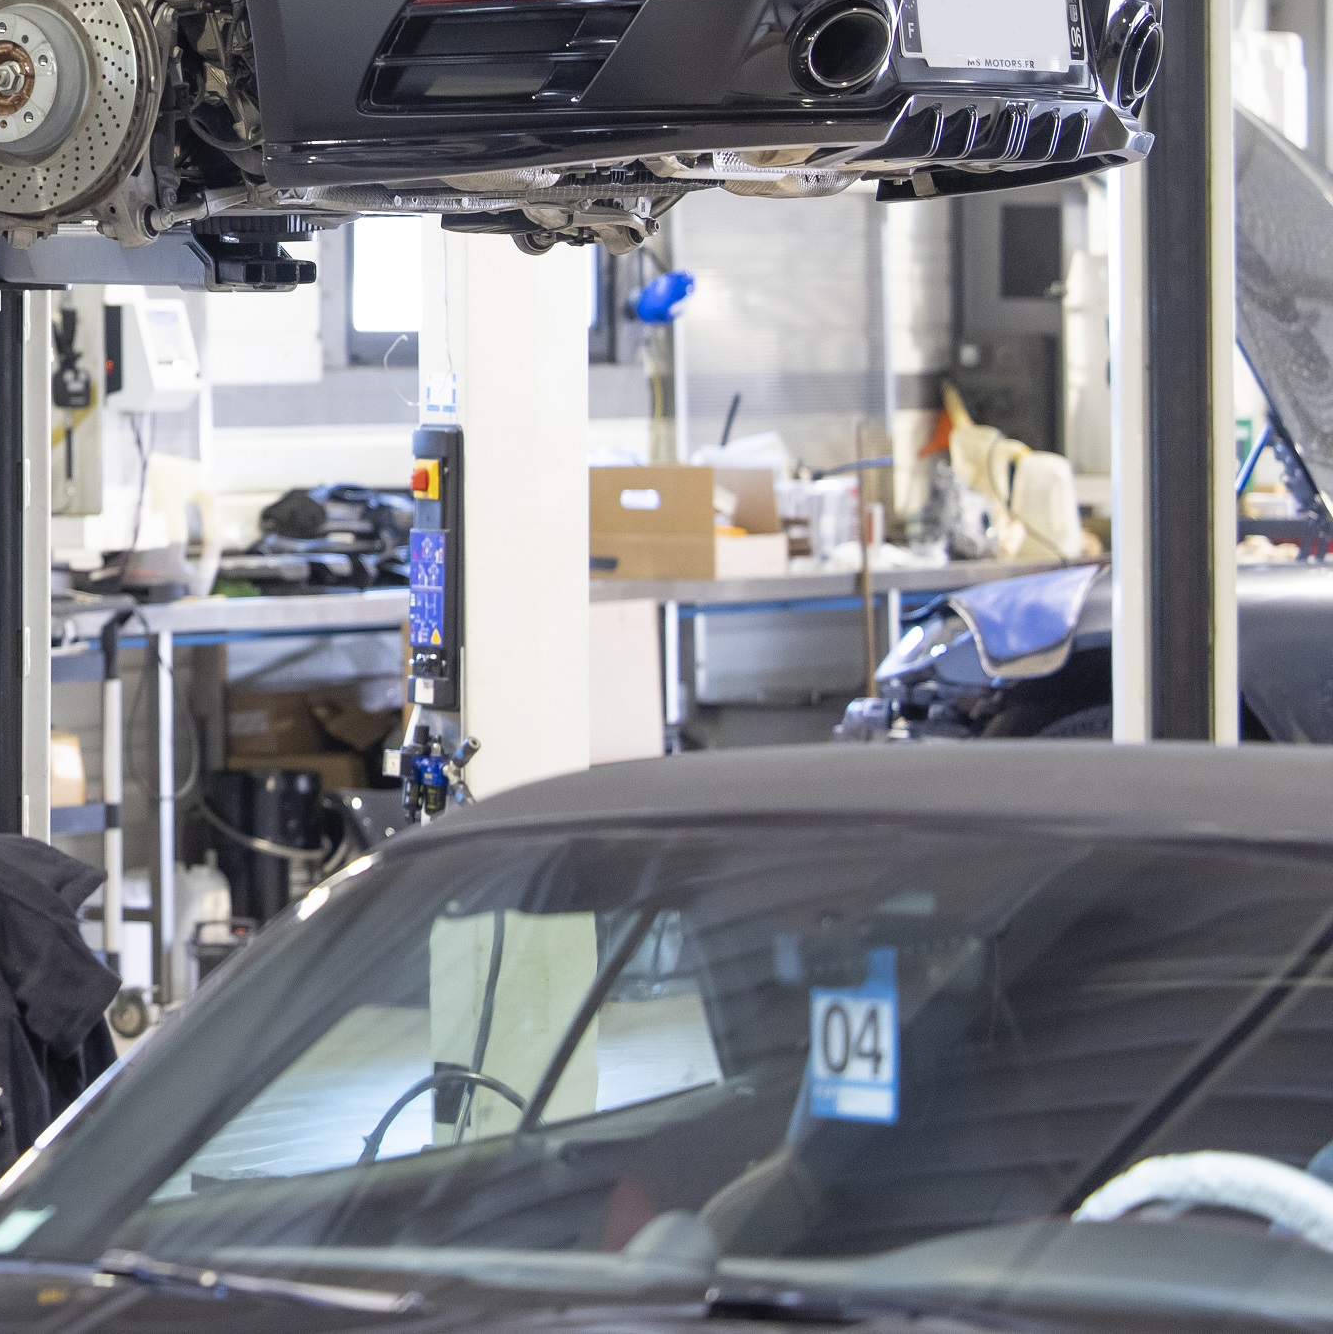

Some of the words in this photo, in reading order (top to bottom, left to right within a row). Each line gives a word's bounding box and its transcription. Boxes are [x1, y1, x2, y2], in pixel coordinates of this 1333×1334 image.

[907, 22, 915, 39] F
[1070, 26, 1082, 48] 06
[984, 59, 1035, 69] MOTORS.FR
[823, 1002, 883, 1076] 04
